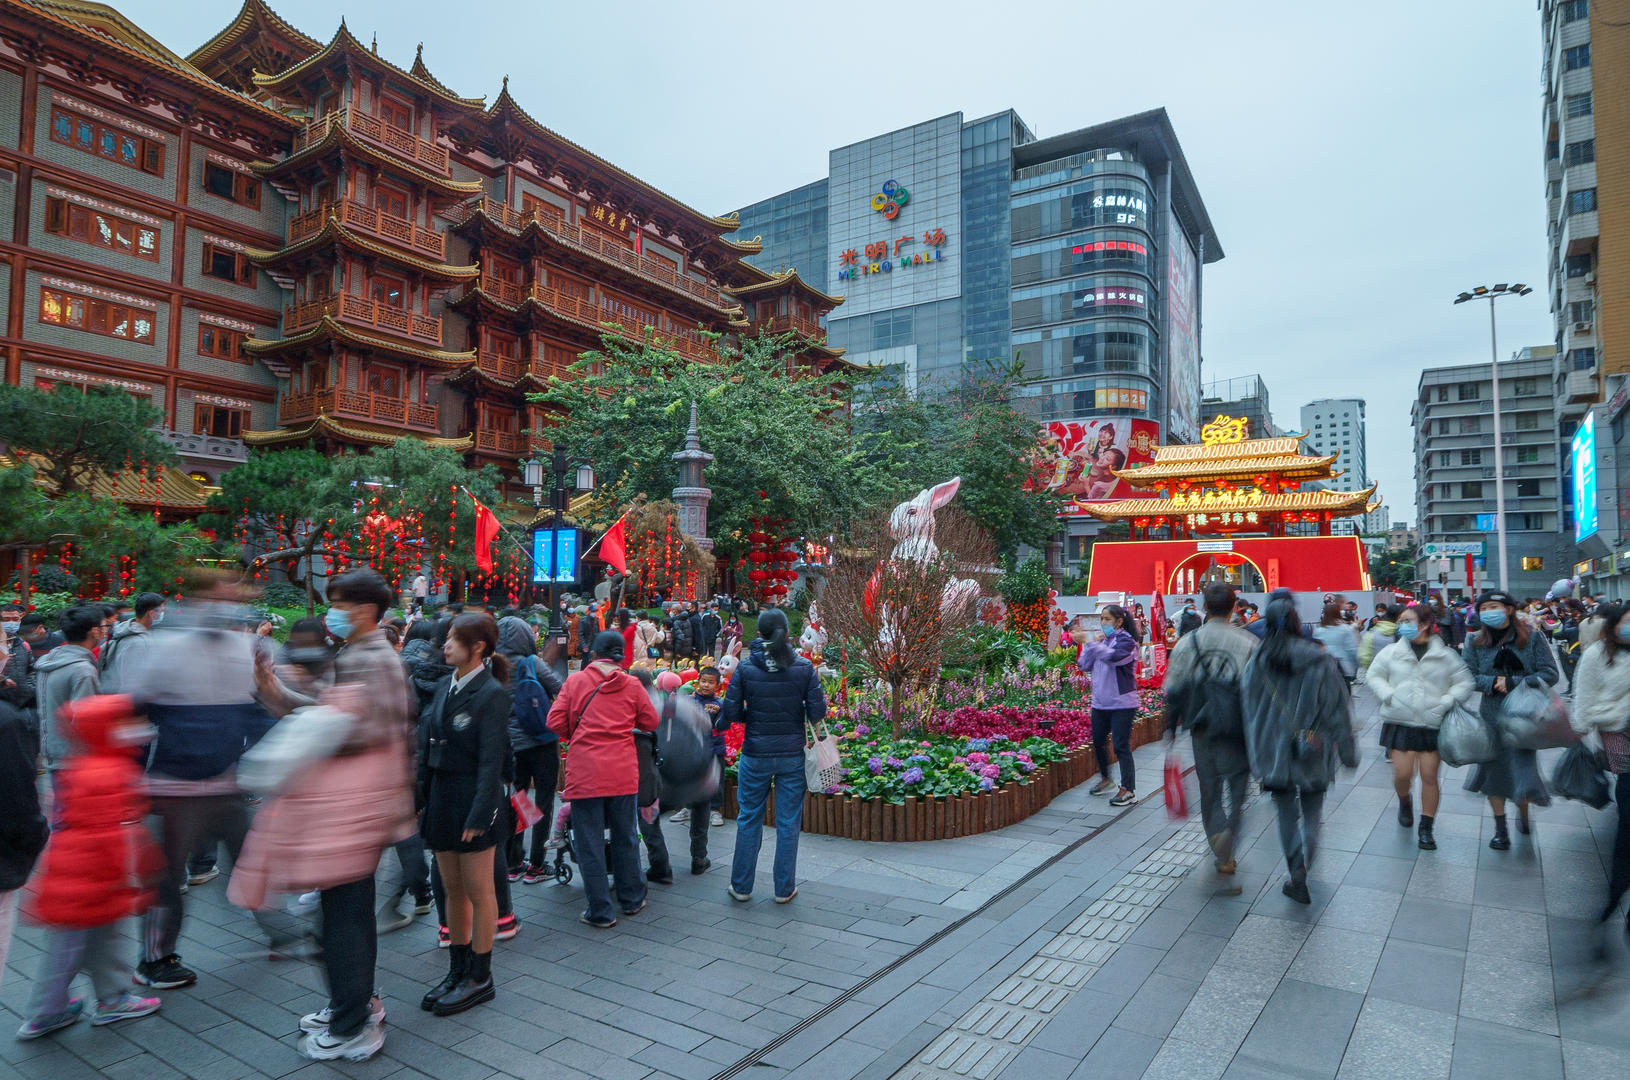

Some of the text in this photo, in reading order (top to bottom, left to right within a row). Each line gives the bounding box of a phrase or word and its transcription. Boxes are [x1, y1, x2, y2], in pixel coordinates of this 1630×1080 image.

[1116, 213, 1136, 224] 9F
[838, 228, 946, 266] 光明广场
[838, 249, 944, 281] METRO MALL
[1201, 416, 1247, 446] 2023
